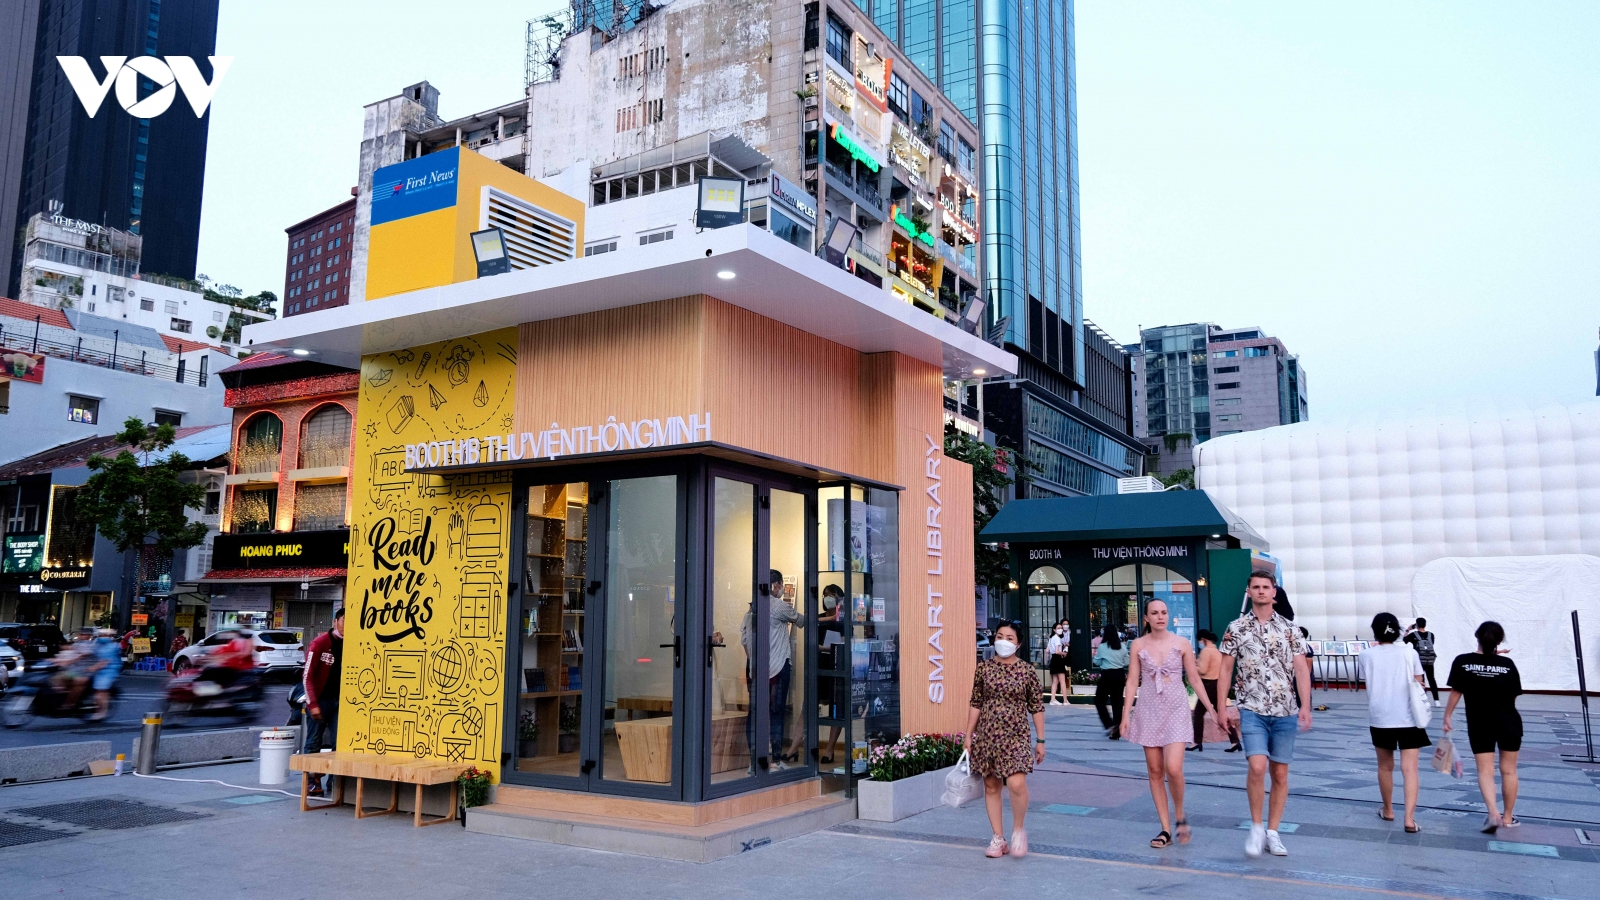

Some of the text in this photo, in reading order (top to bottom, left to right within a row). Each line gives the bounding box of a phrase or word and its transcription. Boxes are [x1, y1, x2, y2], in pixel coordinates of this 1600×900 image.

[897, 121, 931, 160] THE LETTER
[405, 175, 427, 190] First
[429, 170, 454, 184] News
[54, 215, 74, 227] THE
[75, 220, 101, 233] MYST
[405, 439, 464, 470] BOOTH
[528, 421, 577, 460] VIỆN
[574, 415, 654, 455] THÔNG
[653, 412, 711, 447] MINH
[240, 544, 303, 558] HOANG PHUC
[368, 515, 436, 572] Read
[1029, 549, 1062, 560] BOOTH 1A
[1092, 545, 1188, 560] THƯ VIỆN THÔNG MINH
[371, 559, 428, 600] more
[925, 433, 945, 704] SMART LIBRARY
[359, 588, 434, 643] books
